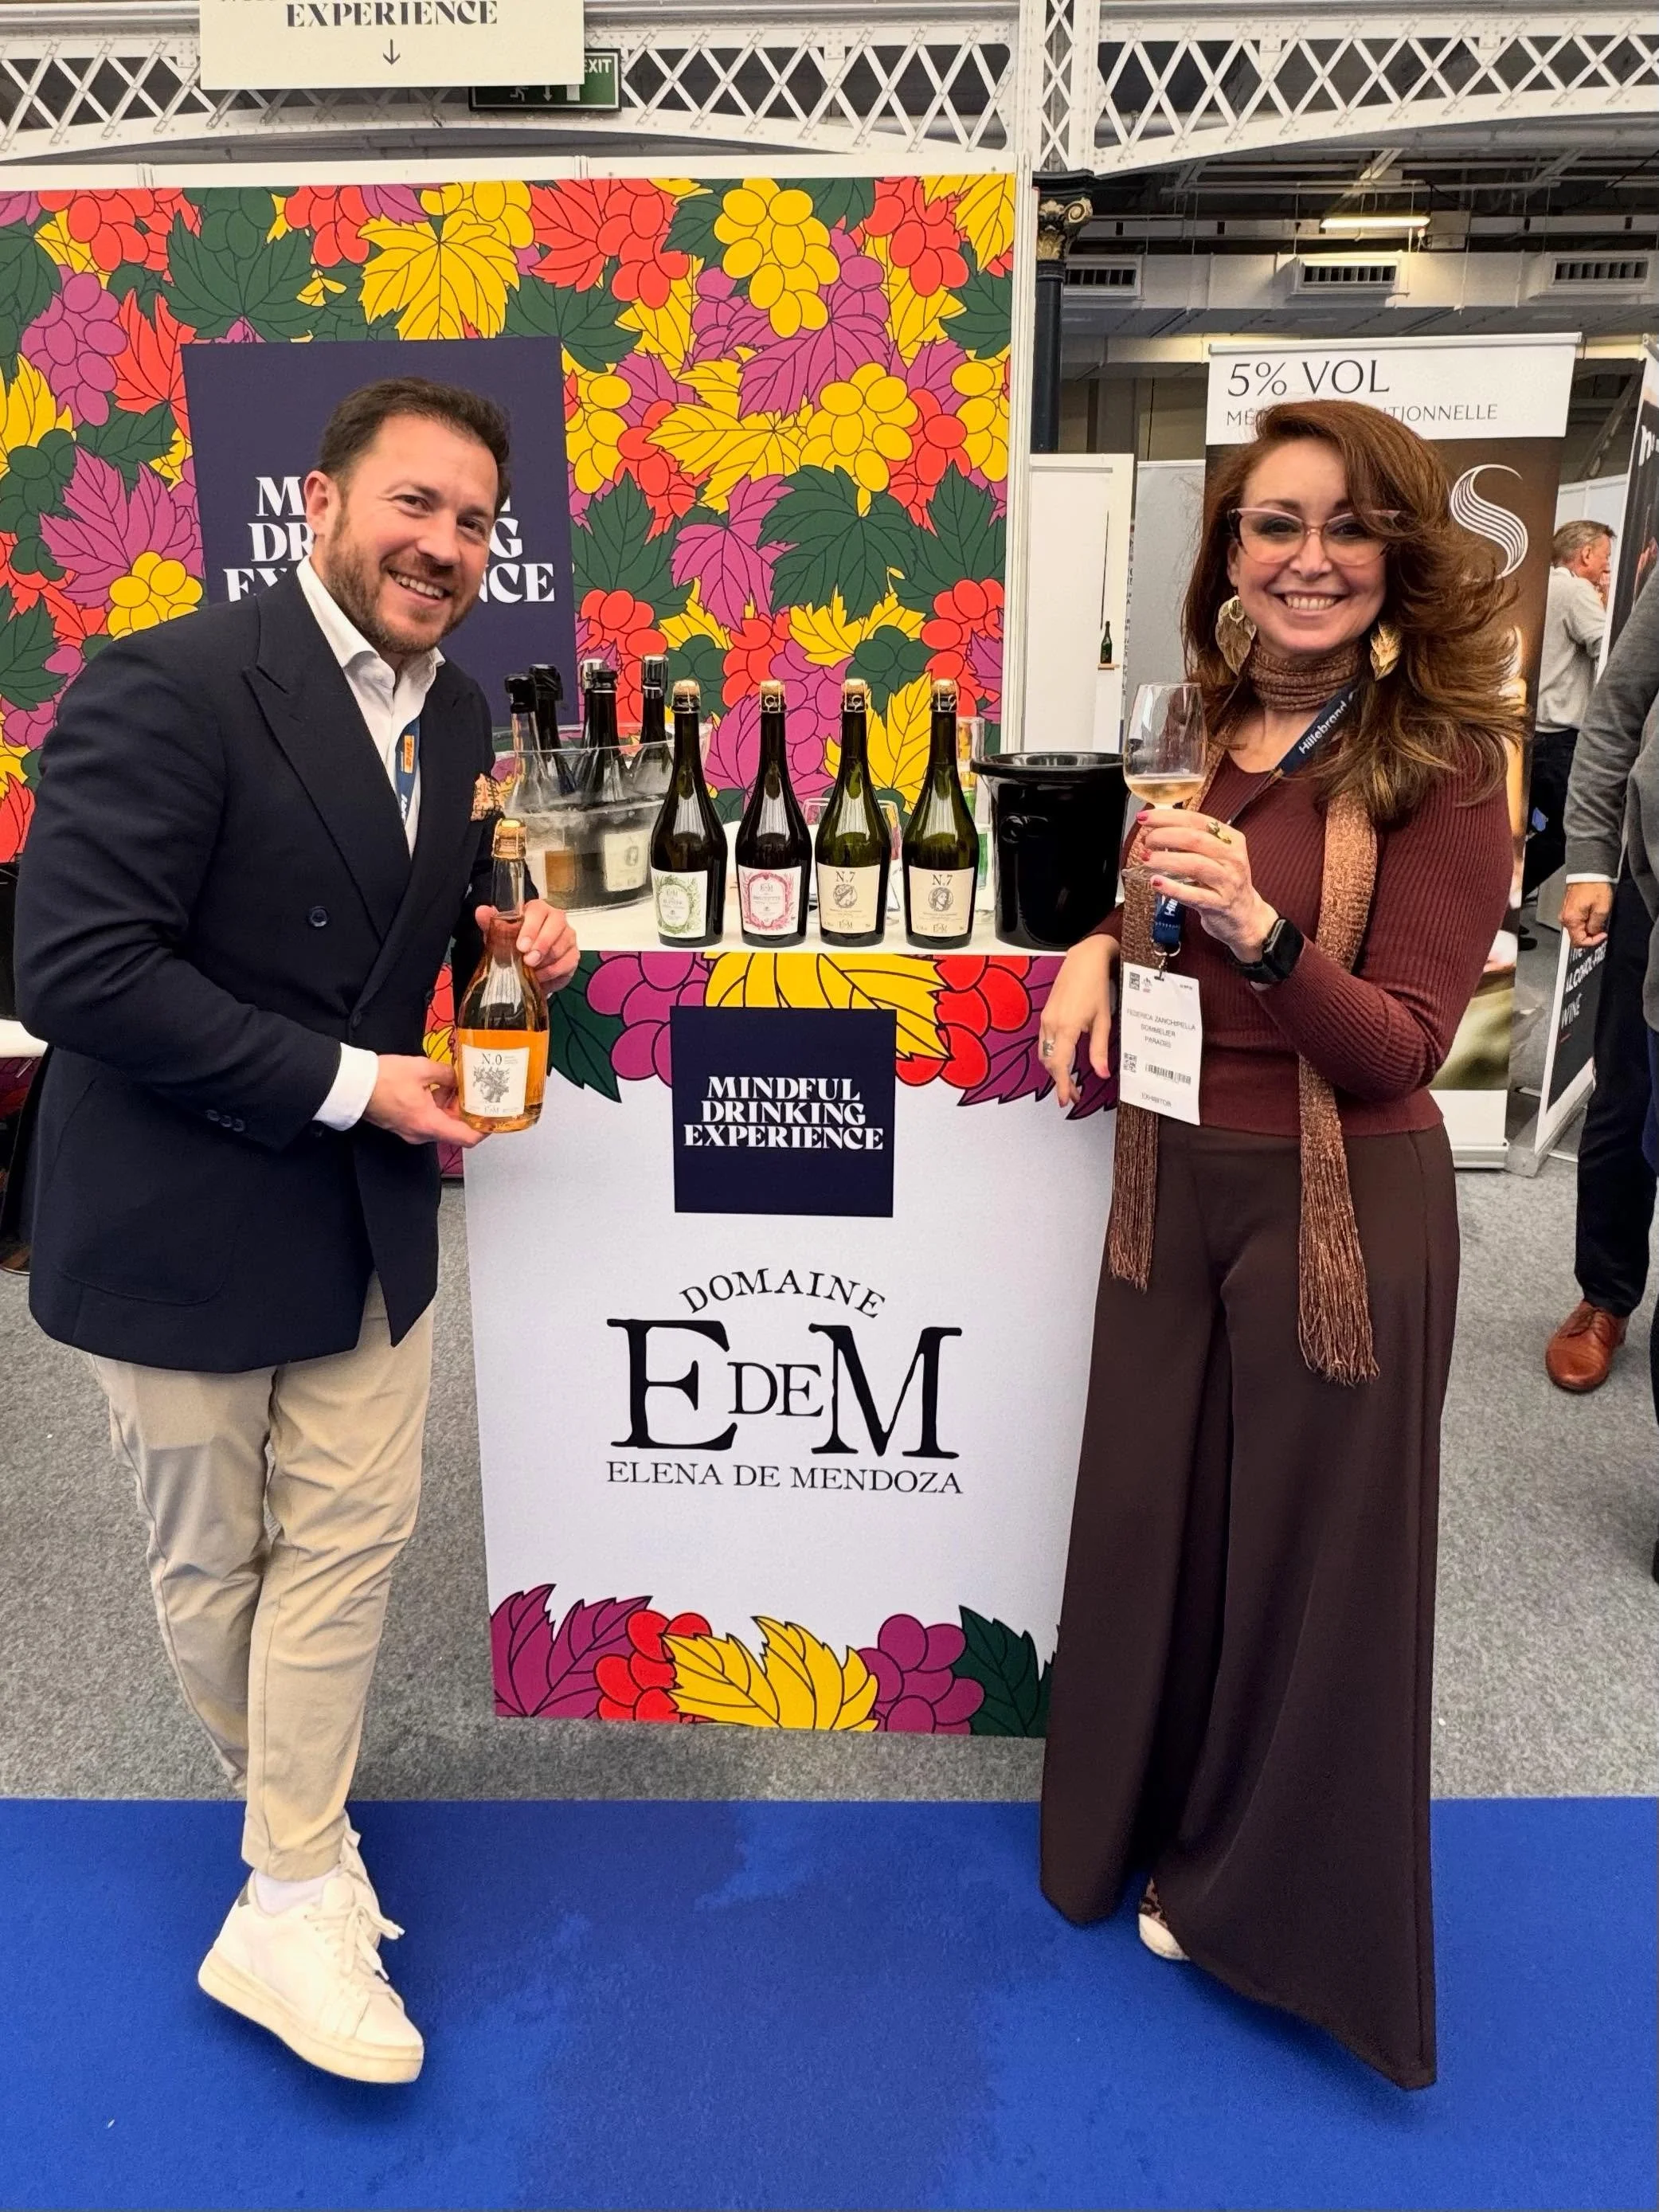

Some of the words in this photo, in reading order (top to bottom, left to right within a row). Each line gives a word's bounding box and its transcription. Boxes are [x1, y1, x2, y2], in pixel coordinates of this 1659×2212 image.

[287, 1, 498, 27] EXPERIENCE
[1227, 362, 1287, 397] 5%
[1302, 359, 1390, 394] VOL
[1383, 404, 1498, 421] TIONNELLE
[706, 1076, 861, 1101] MINDFUL
[702, 1101, 867, 1126] DRINKING
[683, 1124, 884, 1150] EXPERIENCE
[679, 1267, 886, 1319] DOMAINE
[605, 1461, 724, 1486] ELENA
[733, 1463, 781, 1487] DE
[790, 1466, 964, 1494] MENDOZA
